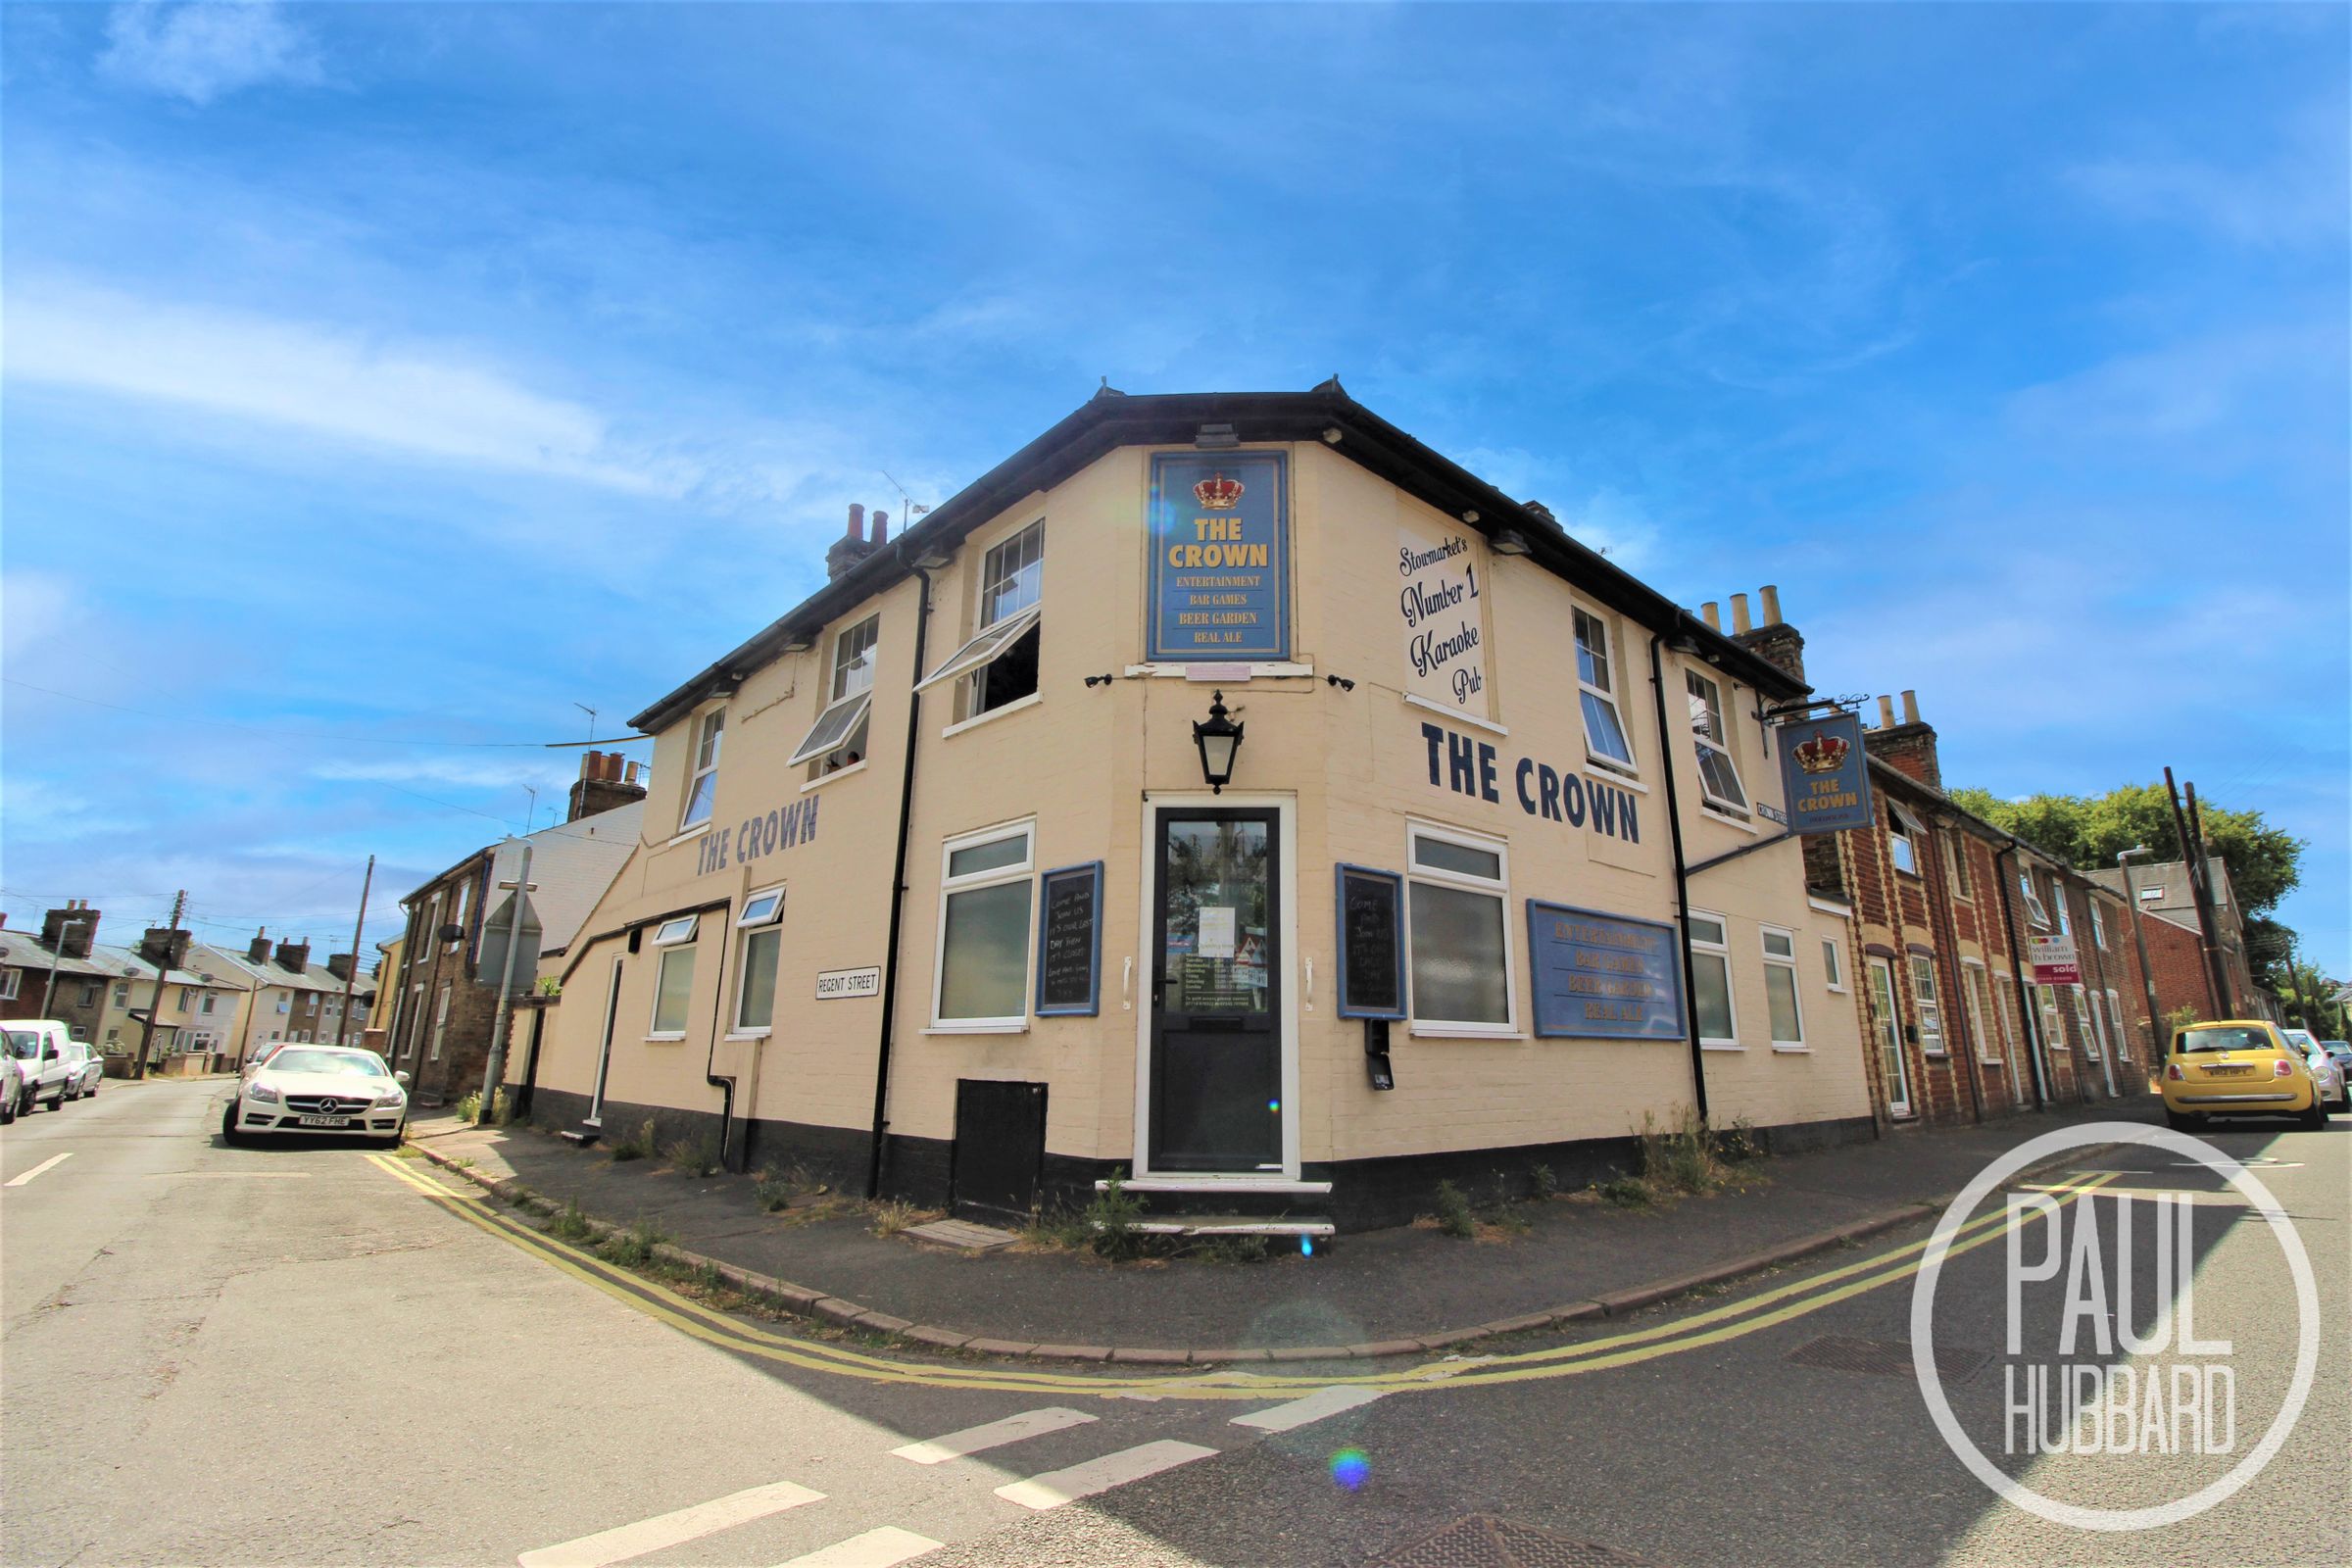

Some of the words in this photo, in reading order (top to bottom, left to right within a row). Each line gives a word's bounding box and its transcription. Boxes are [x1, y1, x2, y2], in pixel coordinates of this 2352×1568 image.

[1194, 517, 1243, 541] THE
[1168, 544, 1268, 568] CROWN
[1399, 535, 1468, 577] Stowmarket's
[1176, 575, 1260, 588] ENTERTAINMENT
[1190, 594, 1209, 605] BAR
[1213, 594, 1247, 605] GAMES
[1400, 579, 1463, 627] Number
[1466, 562, 1479, 600] 1
[1179, 612, 1208, 625] BEER
[1212, 612, 1257, 624] GARDEN
[1195, 632, 1220, 643] REAL
[1222, 632, 1243, 643] ALE
[1409, 620, 1480, 678] Karaoke
[1452, 665, 1482, 705] Pub
[1421, 721, 1499, 805] THE
[1515, 758, 1640, 845] CROWN
[1810, 779, 1839, 795] THE
[1797, 792, 1858, 812] CROWN
[698, 827, 731, 876] THE
[736, 794, 819, 863] CROWN
[2032, 944, 2069, 953] william
[818, 977, 845, 993] REGENT
[848, 974, 876, 990] STREET
[1585, 1003, 1617, 1020] REAL
